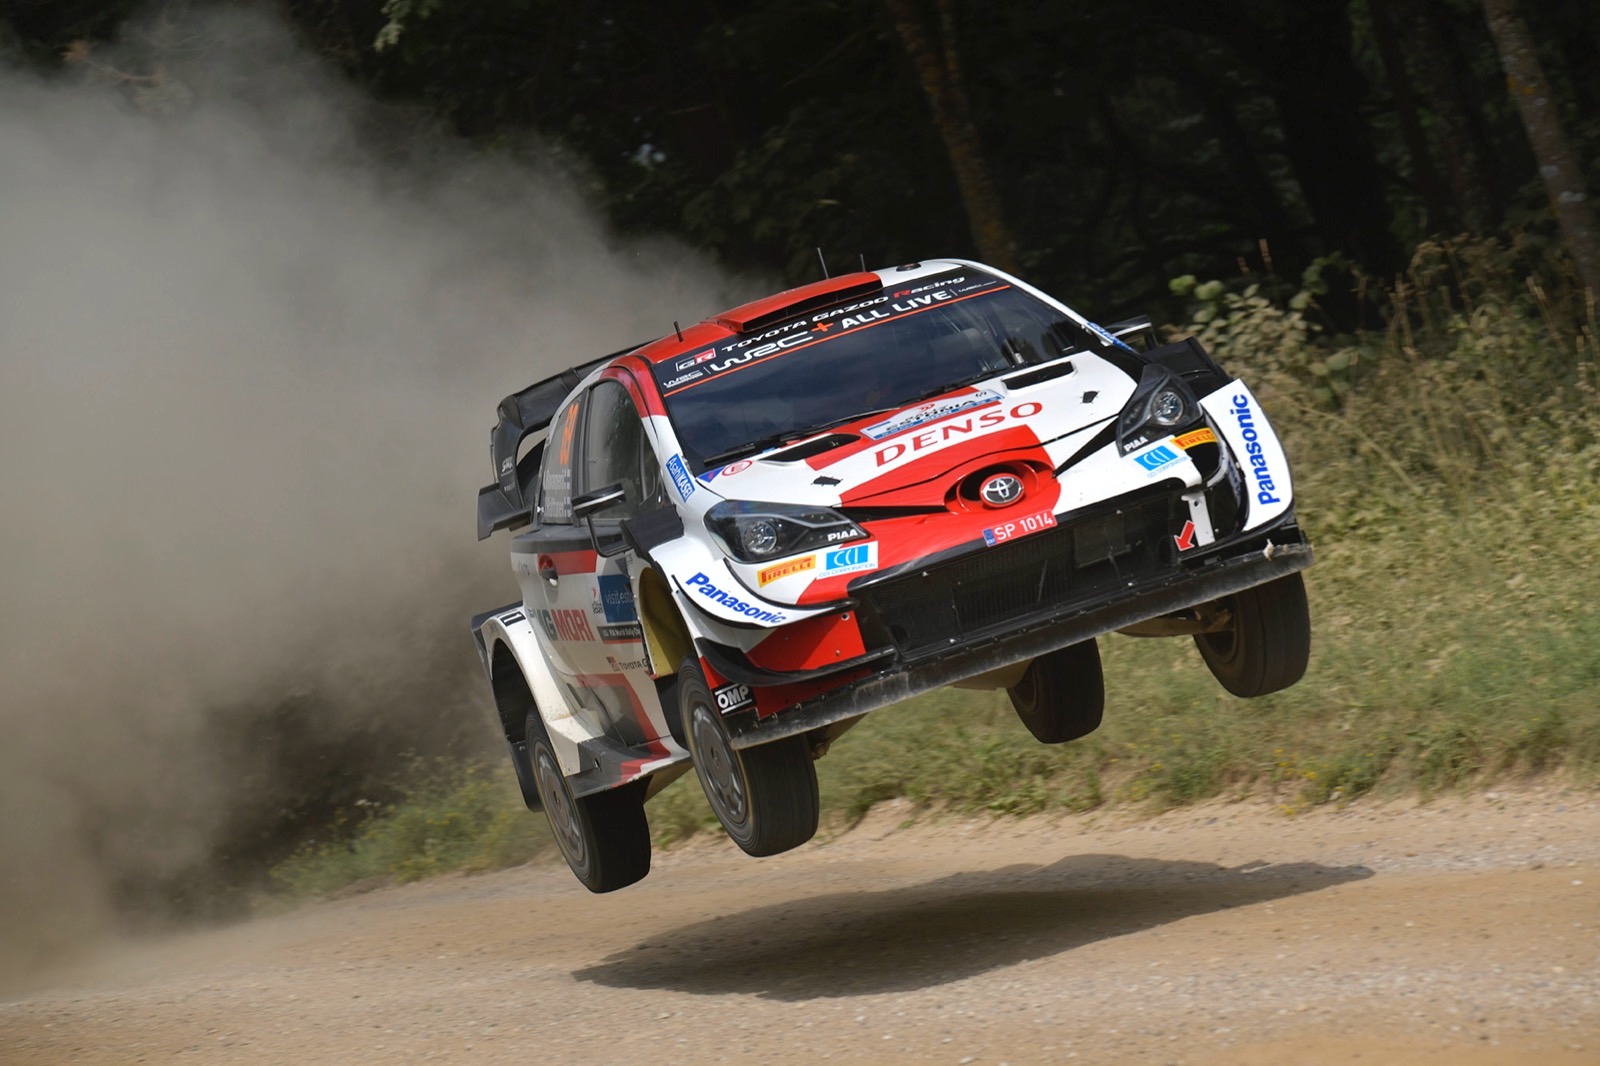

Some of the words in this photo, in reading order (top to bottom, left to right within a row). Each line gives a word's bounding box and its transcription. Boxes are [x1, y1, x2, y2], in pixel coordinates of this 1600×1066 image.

[679, 352, 714, 369] GR
[721, 320, 807, 352] TOYOTA
[812, 296, 889, 322] GAZOO
[893, 276, 965, 298] Racing
[841, 309, 891, 330] ALL
[892, 290, 952, 312] LIVE
[874, 402, 1043, 468] DENSO
[1123, 436, 1149, 452] PIAA
[1230, 393, 1281, 506] Panasonic
[827, 529, 859, 541] PIAA
[994, 523, 1016, 540] SP
[1020, 512, 1053, 532] 1014
[761, 557, 813, 584] PIRELLI
[685, 571, 787, 624] Panasonic
[551, 609, 596, 641] MORI
[717, 685, 750, 709] OMP
